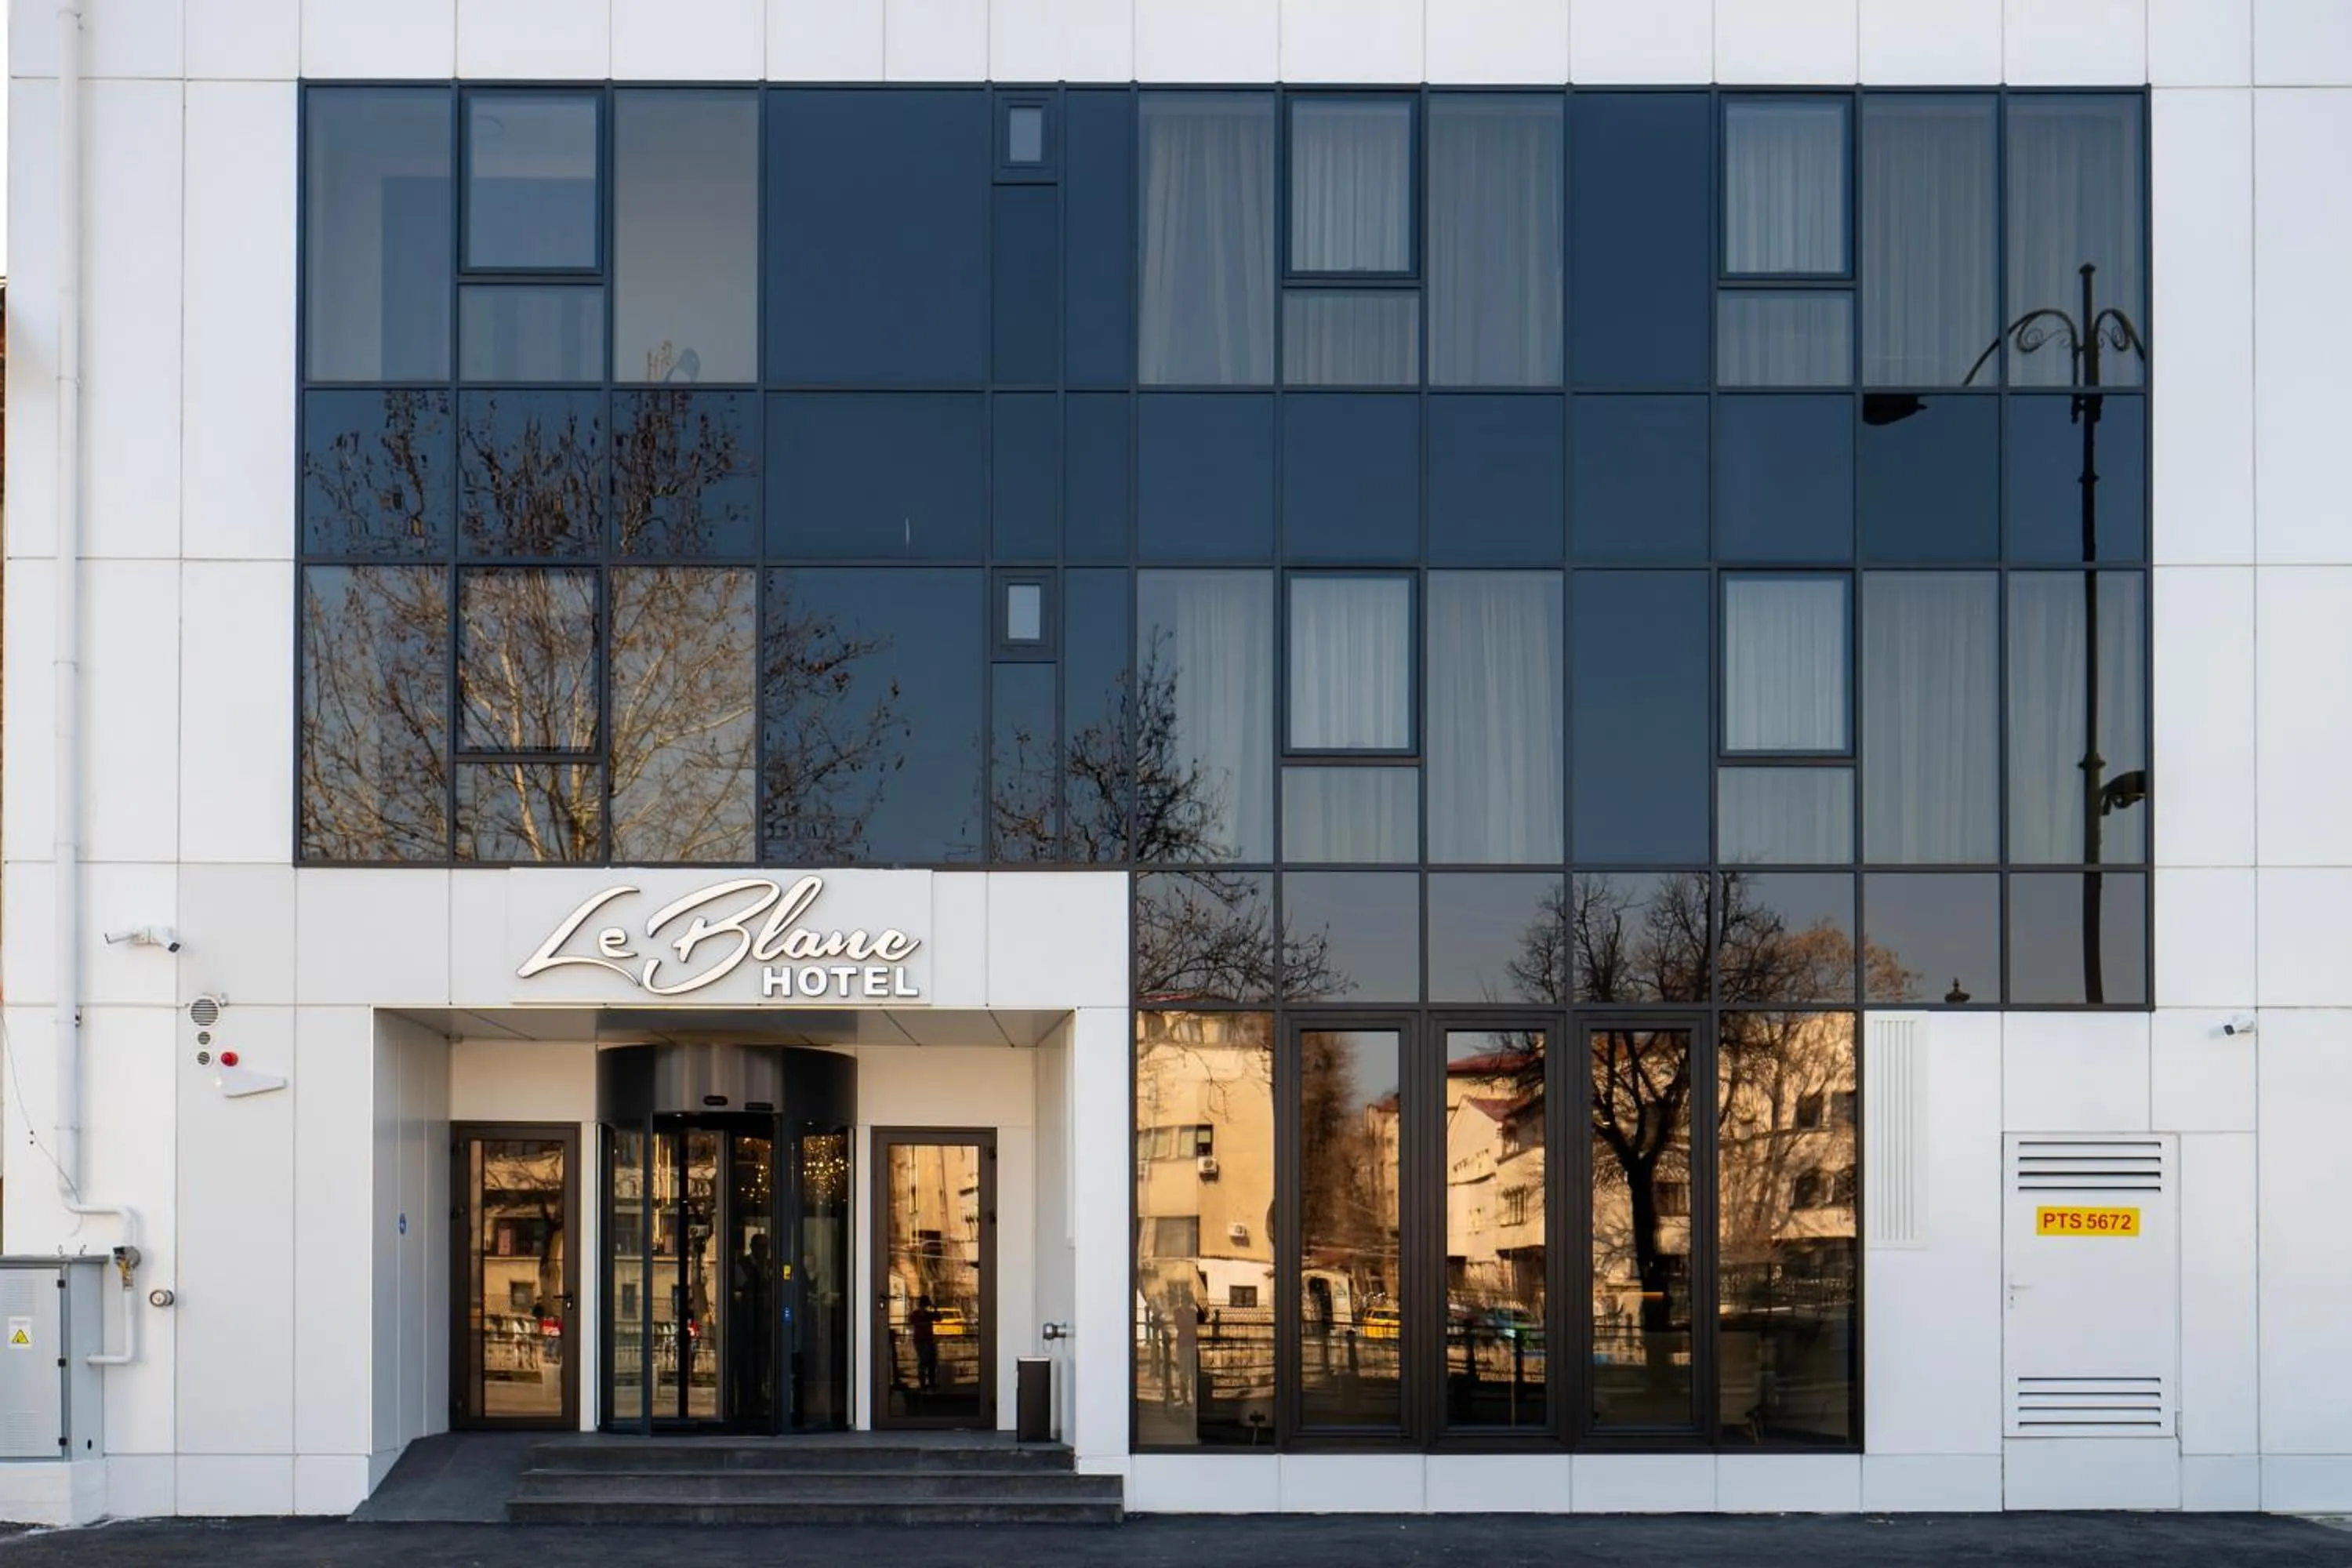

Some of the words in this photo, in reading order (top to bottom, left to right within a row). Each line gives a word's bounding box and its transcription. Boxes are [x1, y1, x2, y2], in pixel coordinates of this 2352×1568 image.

[516, 885, 641, 987] Le
[642, 875, 920, 995] Blanc
[762, 967, 919, 997] HOTEL
[2043, 1213, 2082, 1229] PTS
[2086, 1214, 2132, 1230] 5672
